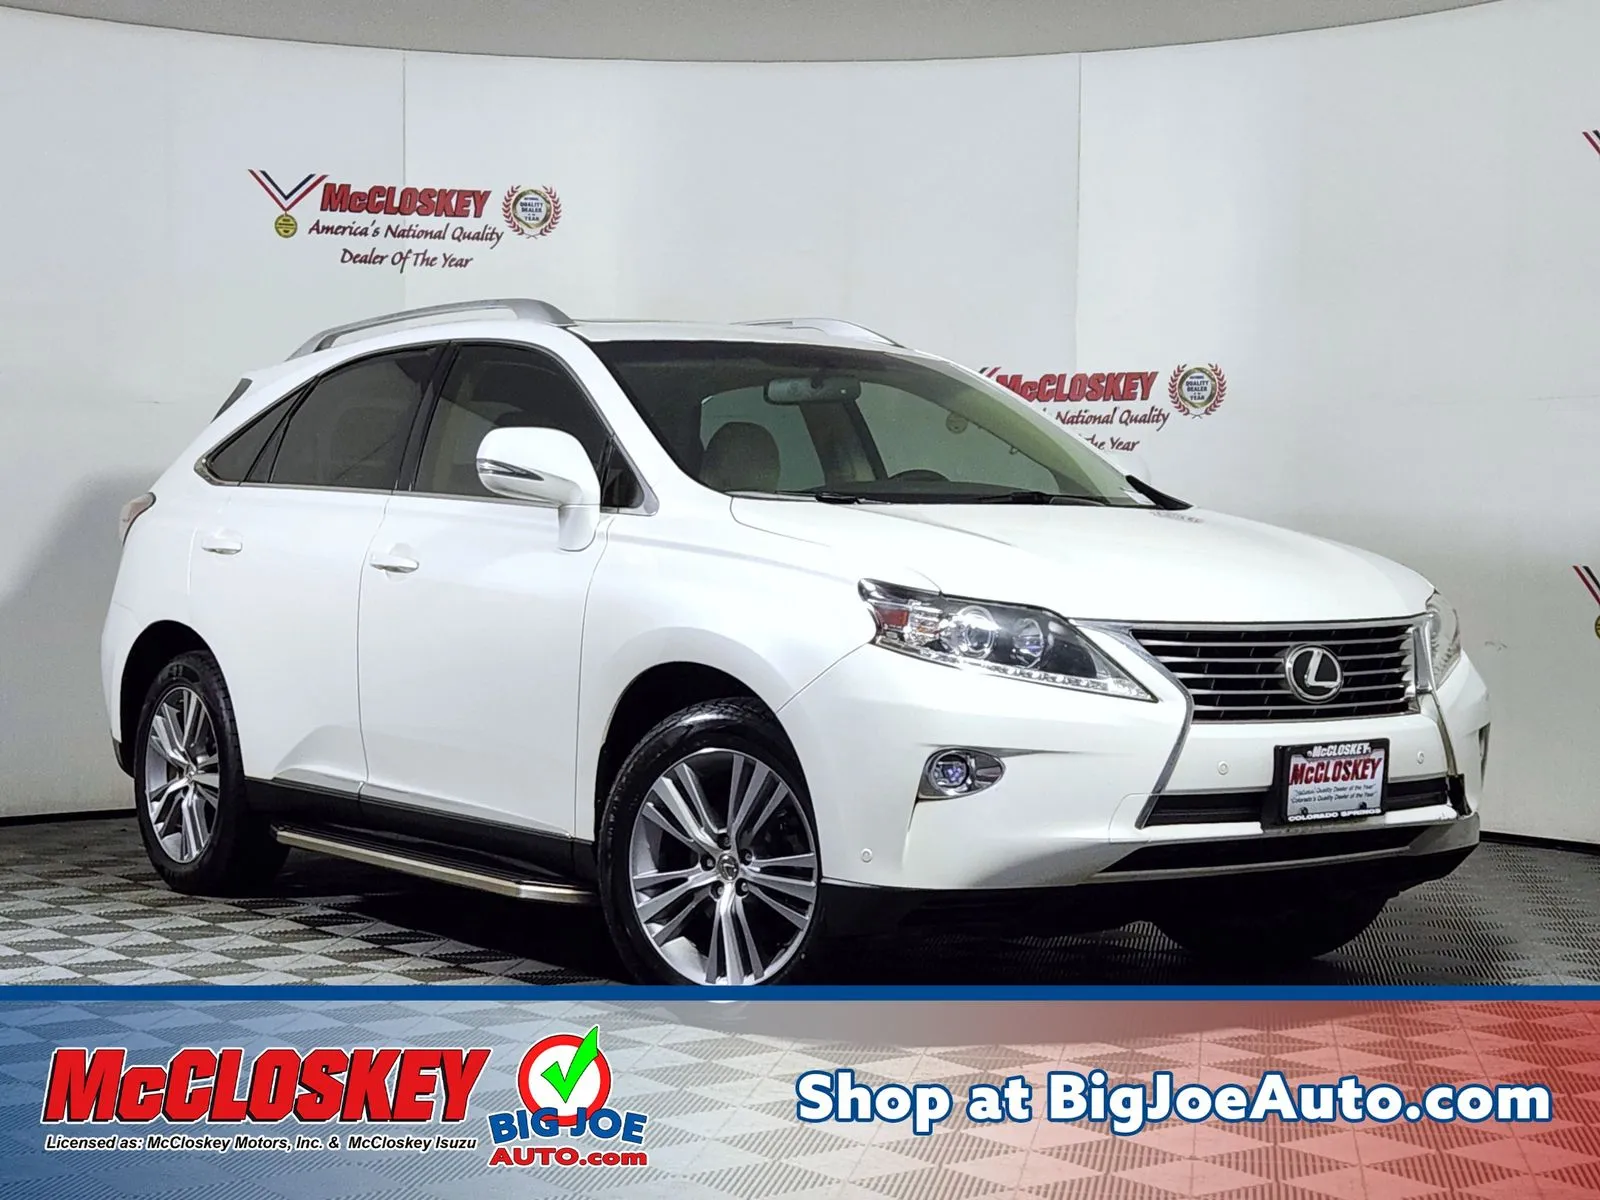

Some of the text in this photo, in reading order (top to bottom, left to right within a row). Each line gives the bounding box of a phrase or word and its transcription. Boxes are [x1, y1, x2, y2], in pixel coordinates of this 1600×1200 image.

[320, 182, 492, 218] McCLOSKEY
[308, 219, 380, 238] America's
[384, 222, 447, 241] National
[451, 222, 504, 249] Quality
[340, 249, 474, 274] Dealer Of The Year
[1055, 405, 1170, 432] National Quality
[1109, 436, 1140, 452] Year
[1312, 743, 1369, 757] McCLOSKEY
[1290, 758, 1382, 785] McCLOSKEY
[1288, 808, 1381, 821] COLORADO SPRINGS
